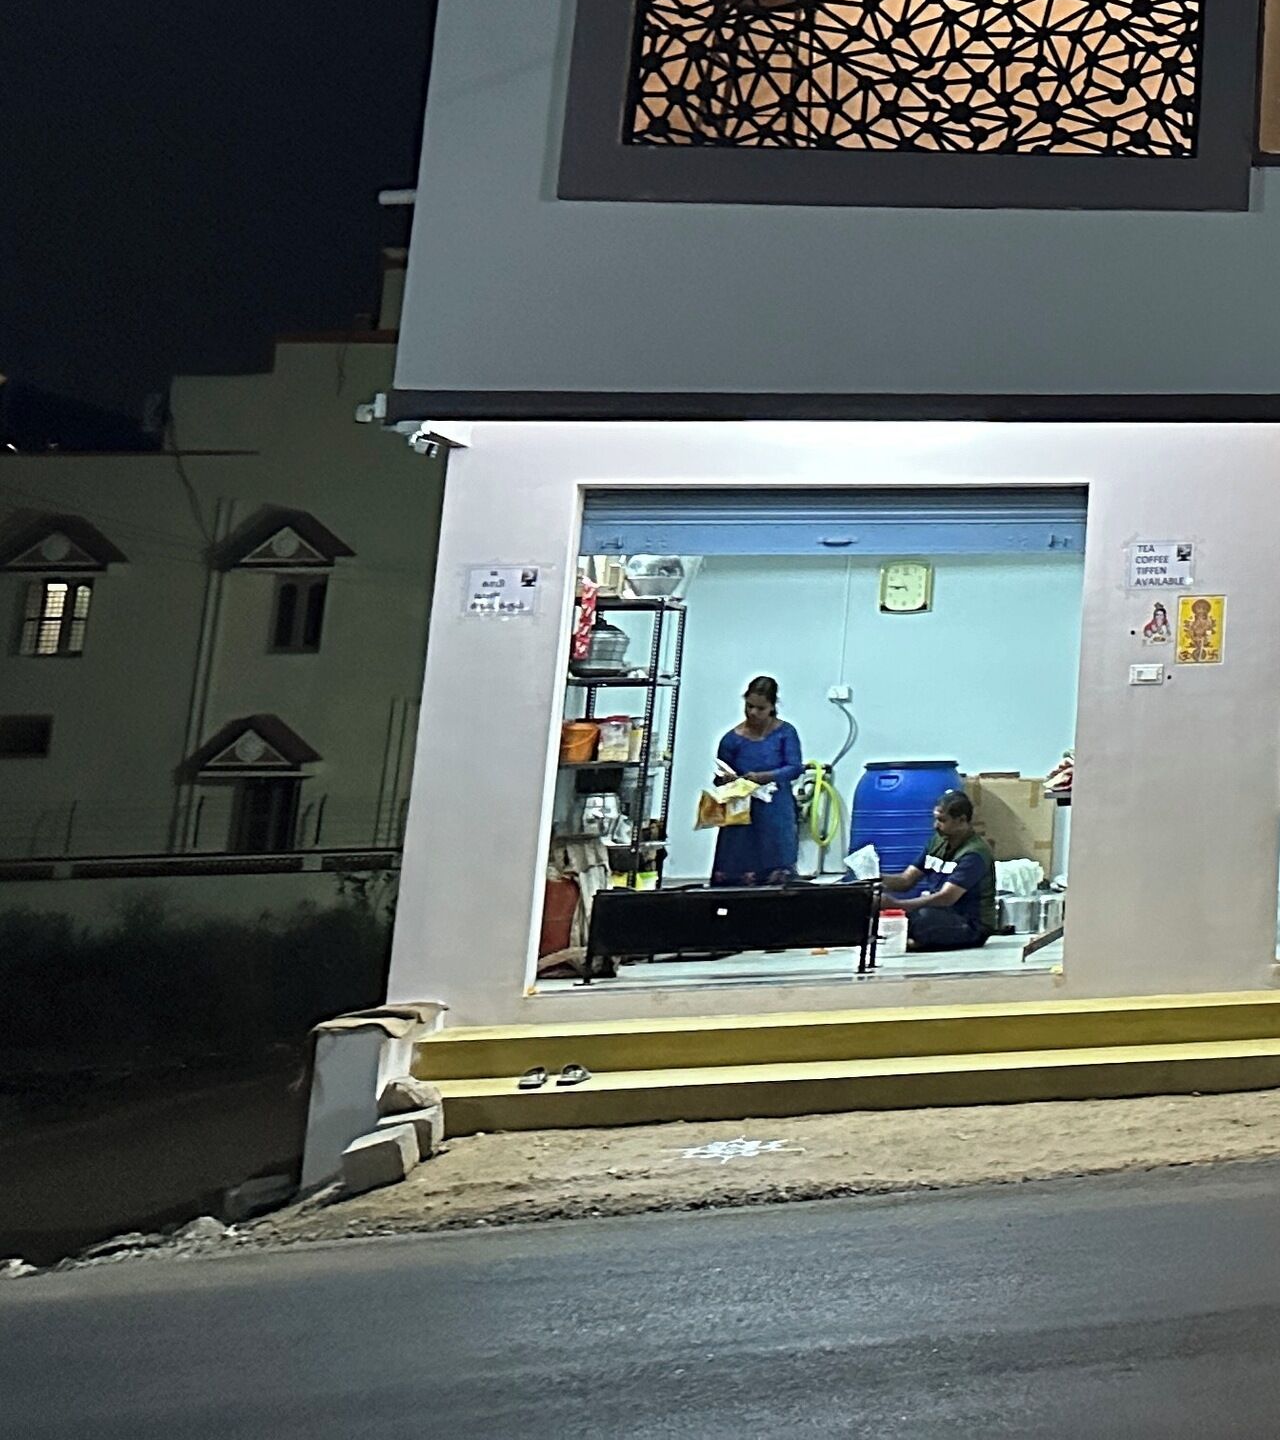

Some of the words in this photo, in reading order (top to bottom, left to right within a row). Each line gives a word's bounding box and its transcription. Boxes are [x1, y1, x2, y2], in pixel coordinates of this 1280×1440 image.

[1137, 545, 1155, 553] TEA
[1135, 555, 1169, 564] COFFEE
[1136, 567, 1168, 575] TIFFEN
[1135, 577, 1185, 586] AVAILABLE
